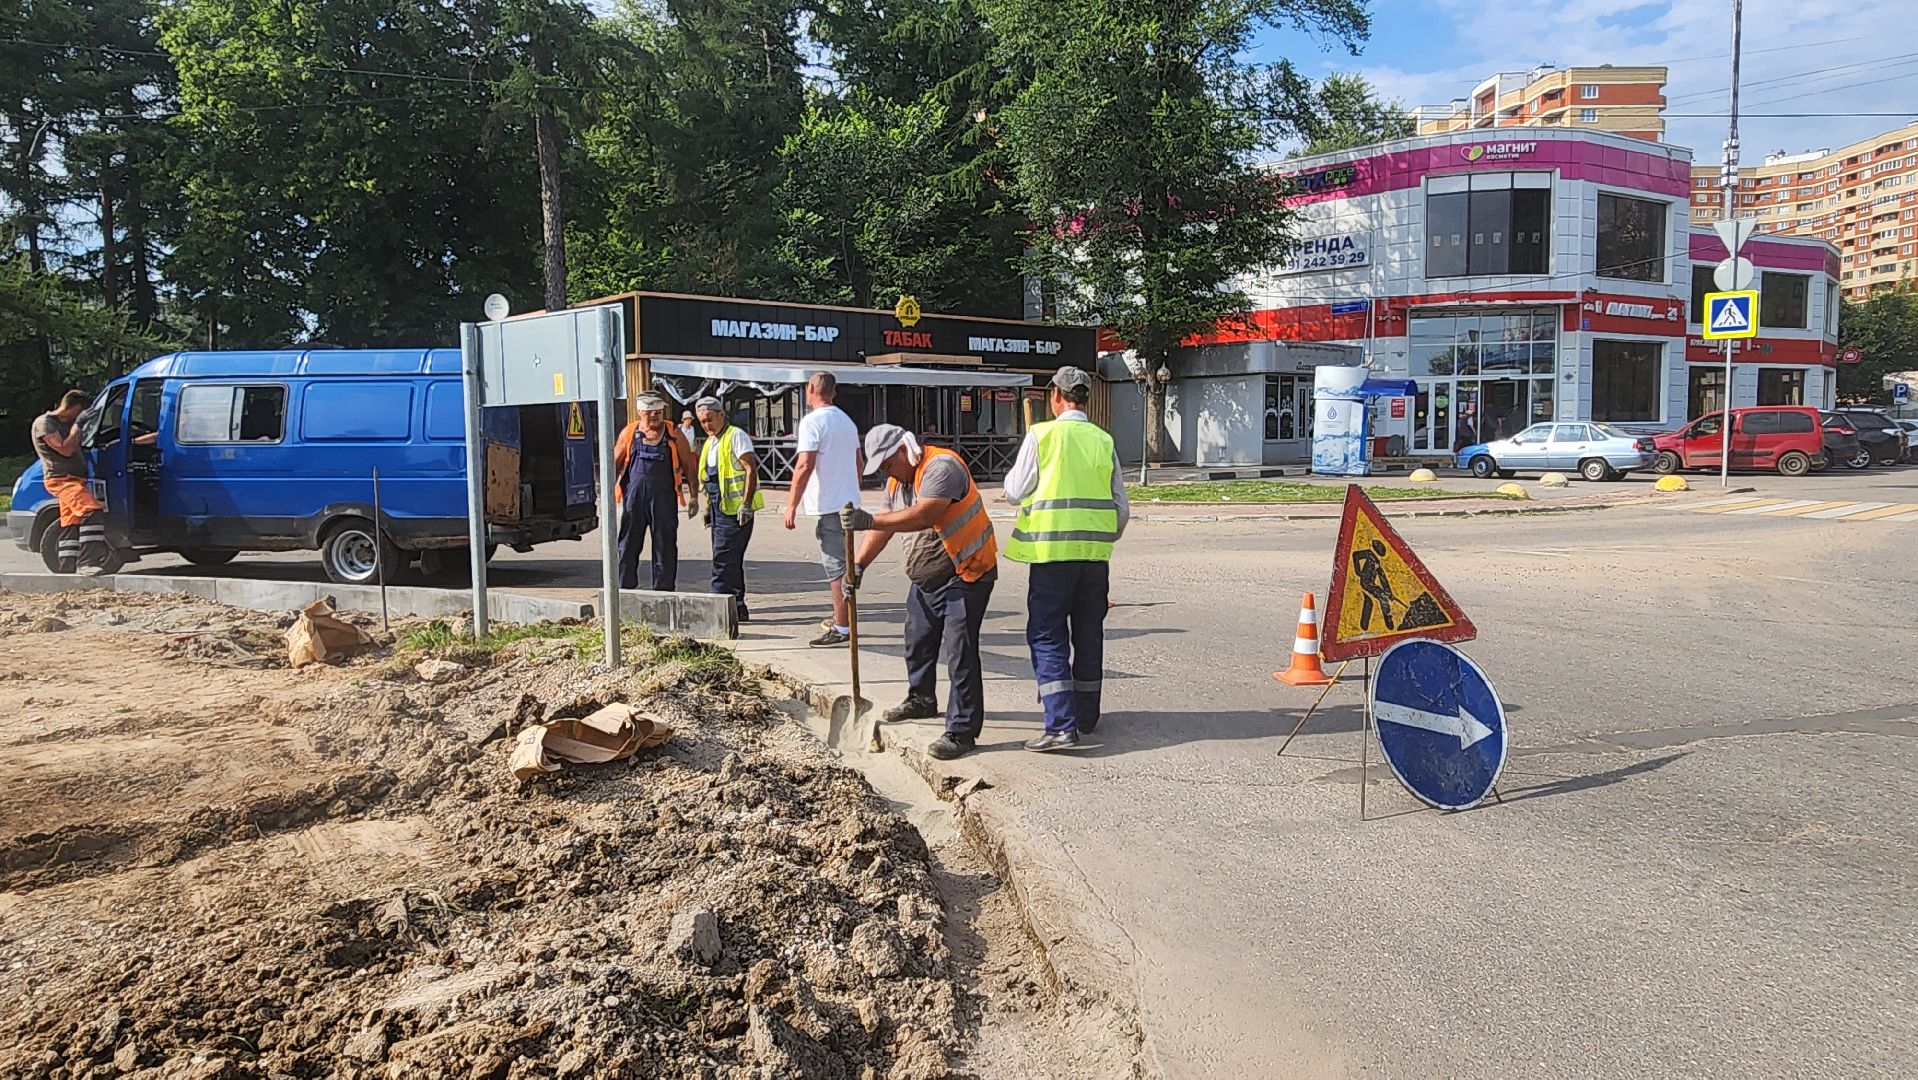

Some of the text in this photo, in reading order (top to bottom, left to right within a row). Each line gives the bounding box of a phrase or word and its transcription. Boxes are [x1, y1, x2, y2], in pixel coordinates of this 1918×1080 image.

[1303, 257, 1327, 269] 242
[1330, 254, 1345, 266] 39
[1349, 252, 1365, 264] 29
[711, 319, 839, 342] МАГАЗИН-БАР
[883, 330, 933, 348] ТАБАК
[968, 336, 1062, 355] МАГАЗИН-БАР
